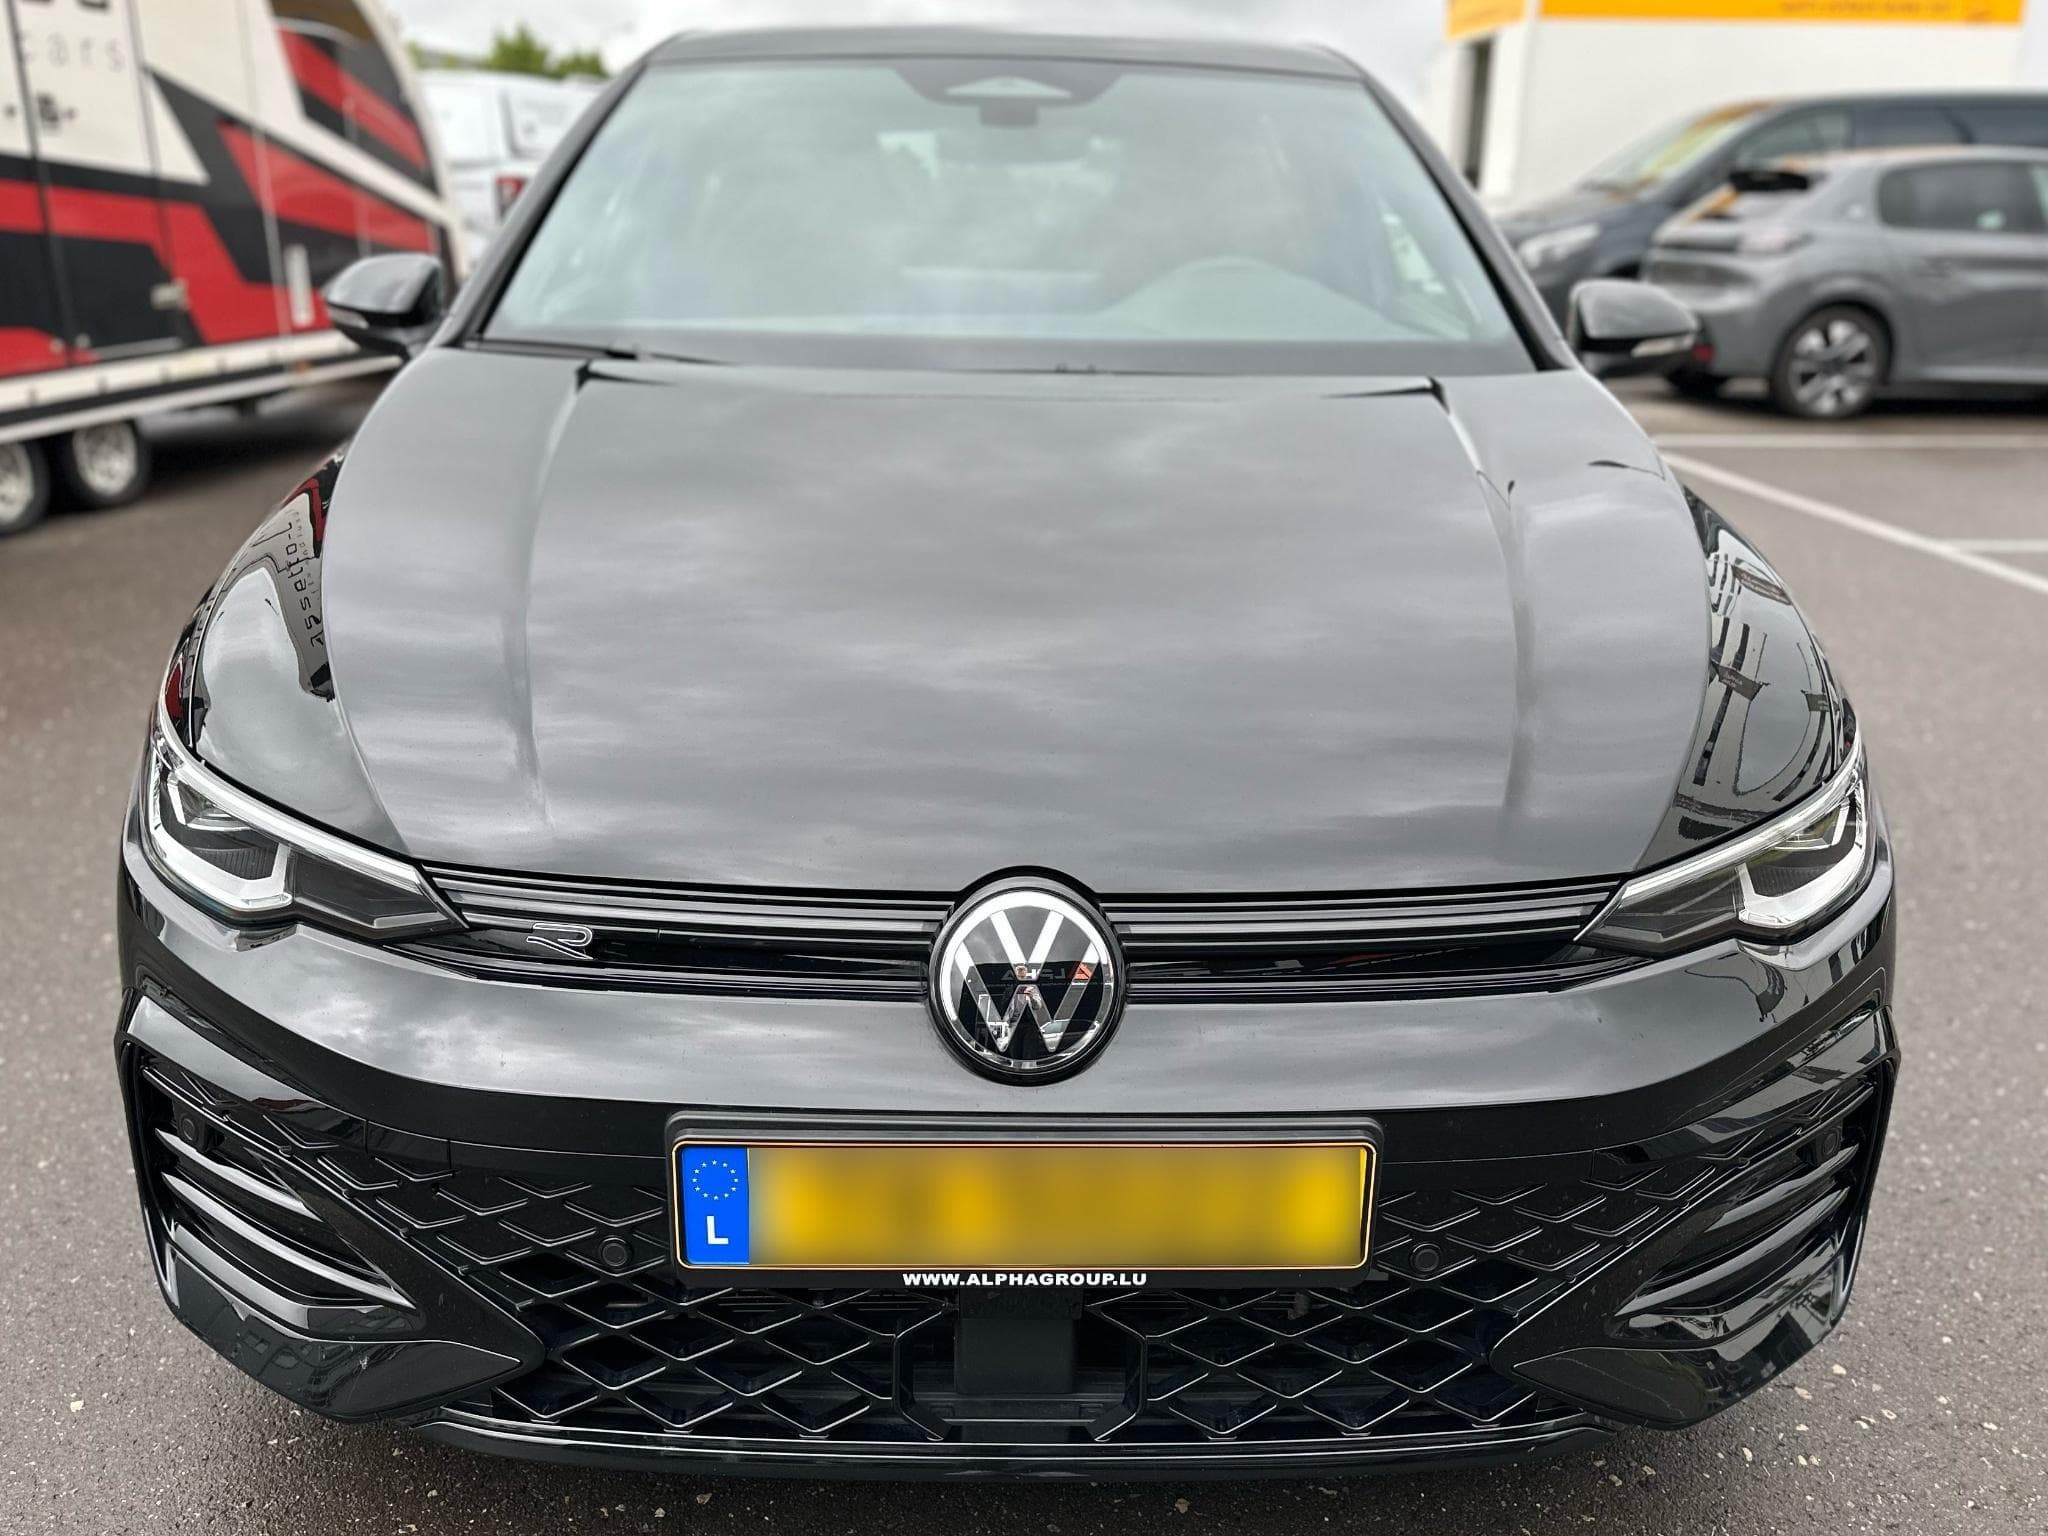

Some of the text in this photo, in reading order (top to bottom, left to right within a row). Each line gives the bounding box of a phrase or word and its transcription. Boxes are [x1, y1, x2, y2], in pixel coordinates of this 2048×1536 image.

[526, 922, 594, 960] R
[706, 1215, 729, 1245] L
[902, 1273, 1147, 1286] WWW.ALPHAGROUP.LU
